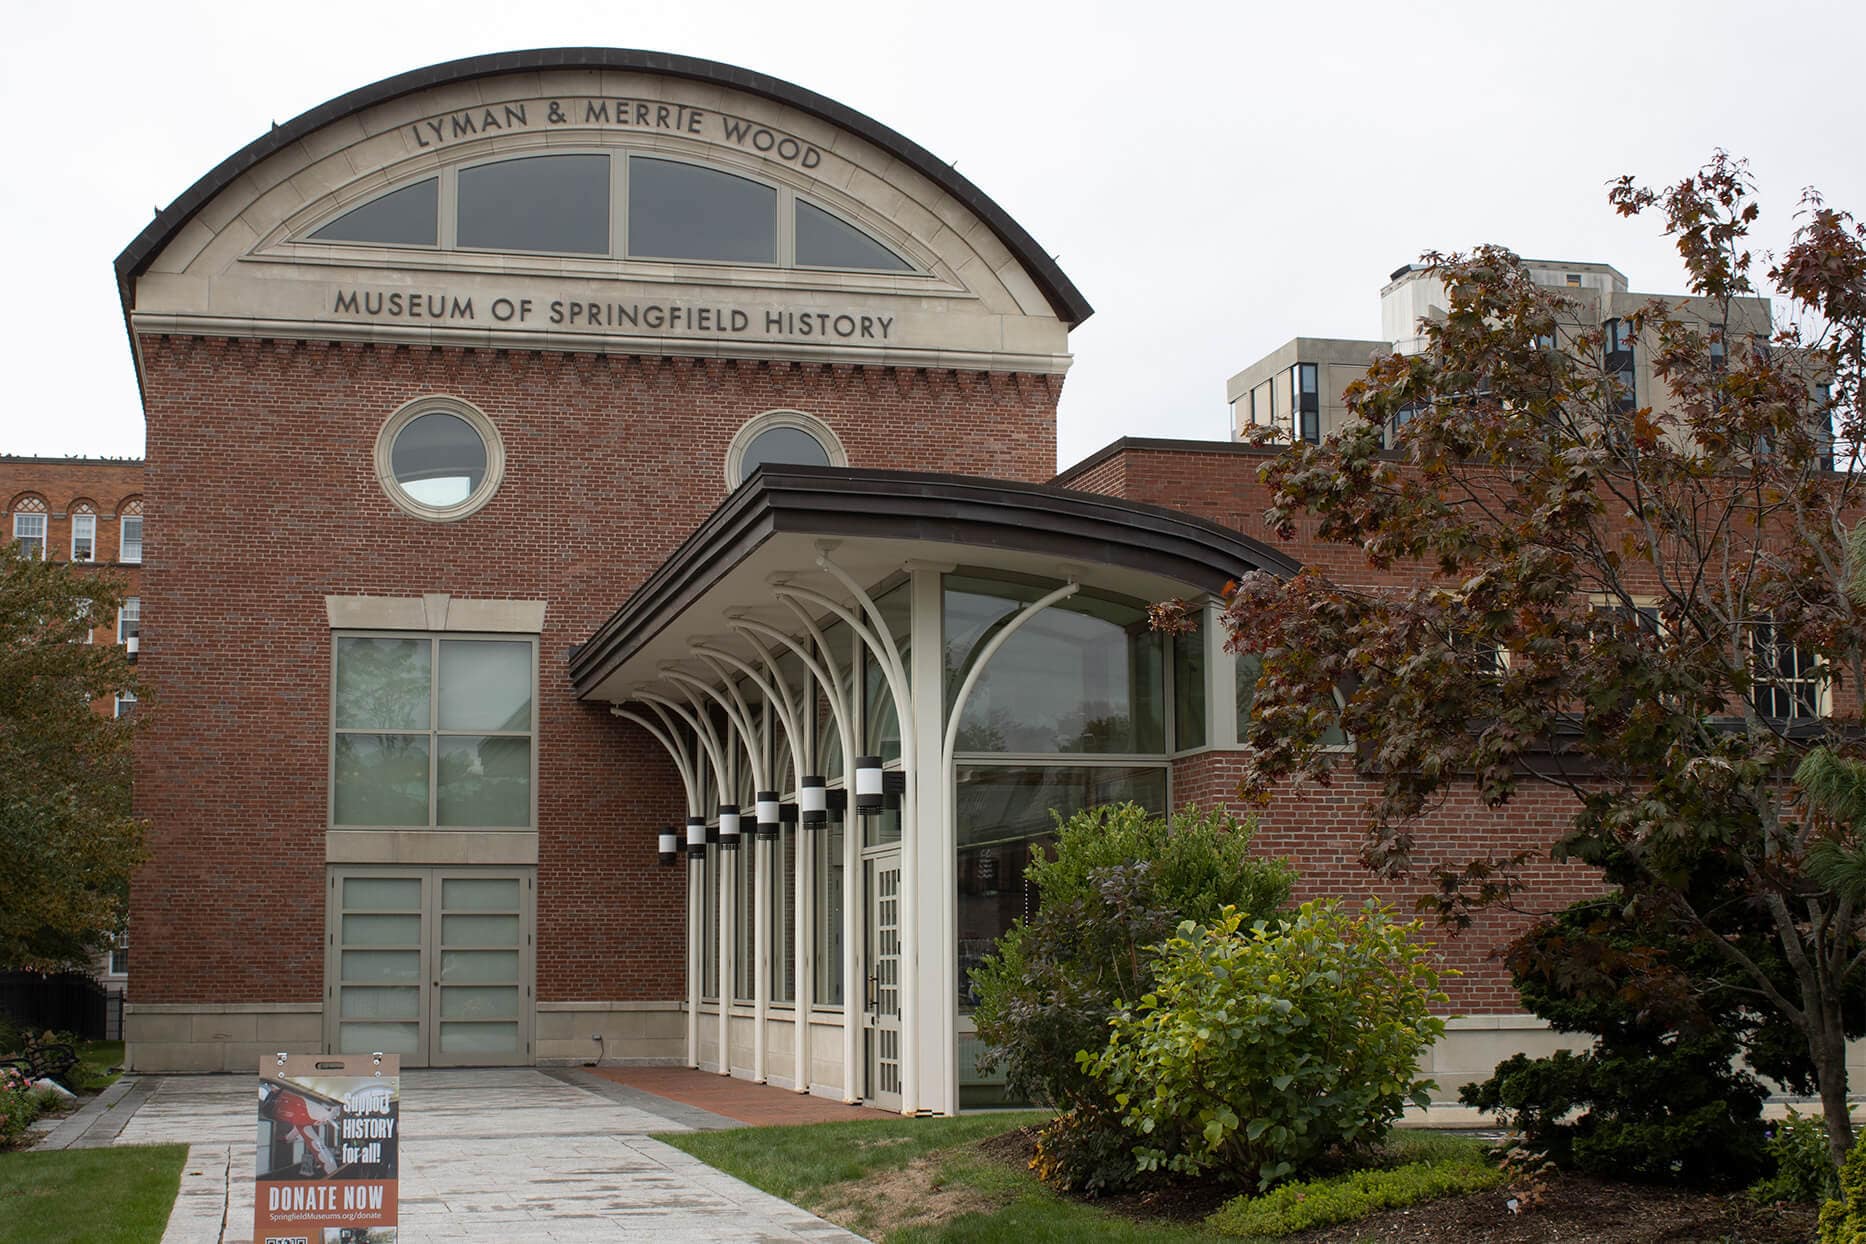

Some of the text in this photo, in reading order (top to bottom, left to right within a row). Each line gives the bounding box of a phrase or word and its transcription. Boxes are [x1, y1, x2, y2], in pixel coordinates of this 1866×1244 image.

[413, 100, 822, 170] LYMAN & MERRIE WOOD
[334, 289, 894, 339] MUSEUM OF SPRINGFIELD HISTORY
[343, 1092, 391, 1117] Support
[342, 1118, 395, 1139] HISTORY
[342, 1142, 381, 1164] for all!
[268, 1185, 384, 1211] DONATE NOW
[269, 1212, 382, 1223] SpringfieldMuseums.org/donate
